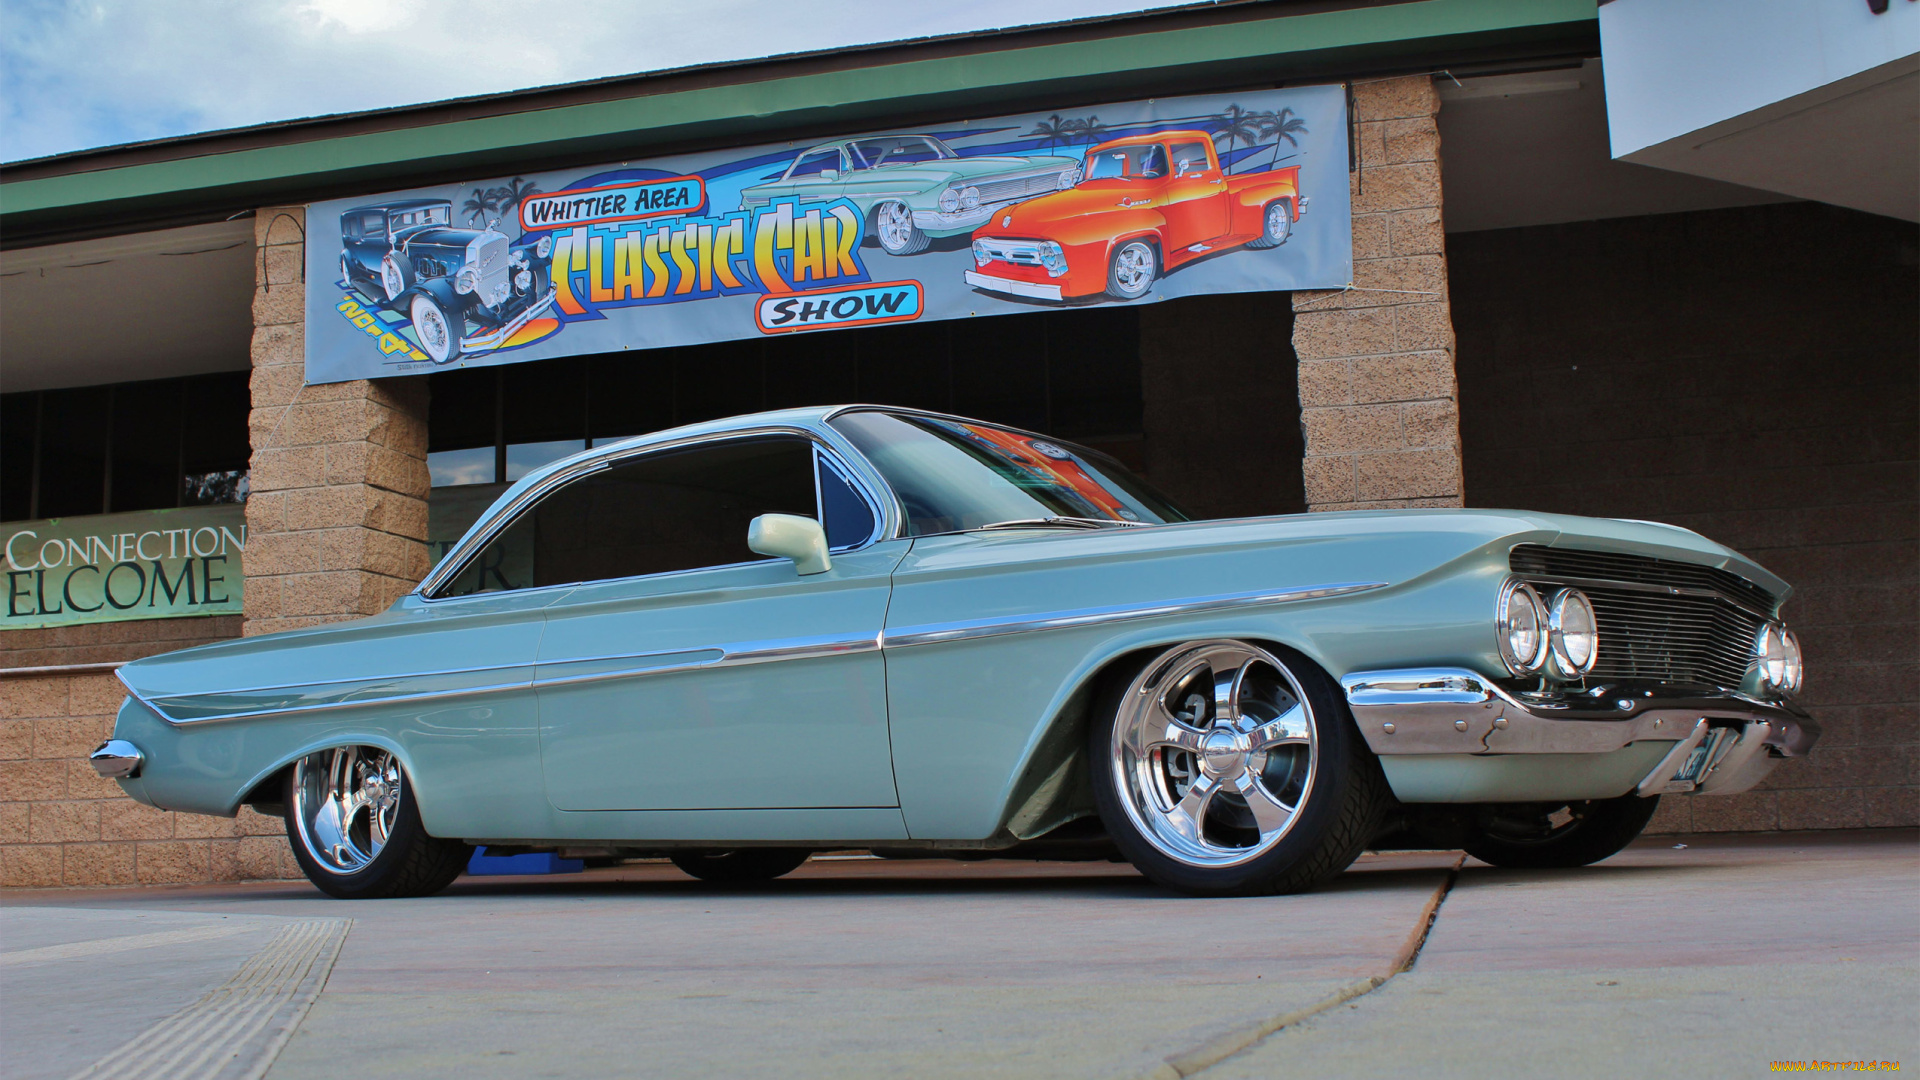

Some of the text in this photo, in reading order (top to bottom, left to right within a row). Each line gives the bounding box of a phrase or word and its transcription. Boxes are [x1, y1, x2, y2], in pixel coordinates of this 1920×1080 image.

[529, 186, 689, 224] WHITTIER AREA
[550, 202, 861, 315] CLASSIC CAR
[771, 292, 909, 325] SHOW
[5, 524, 247, 571] CONNECTION
[0, 554, 229, 617] ELCOME
